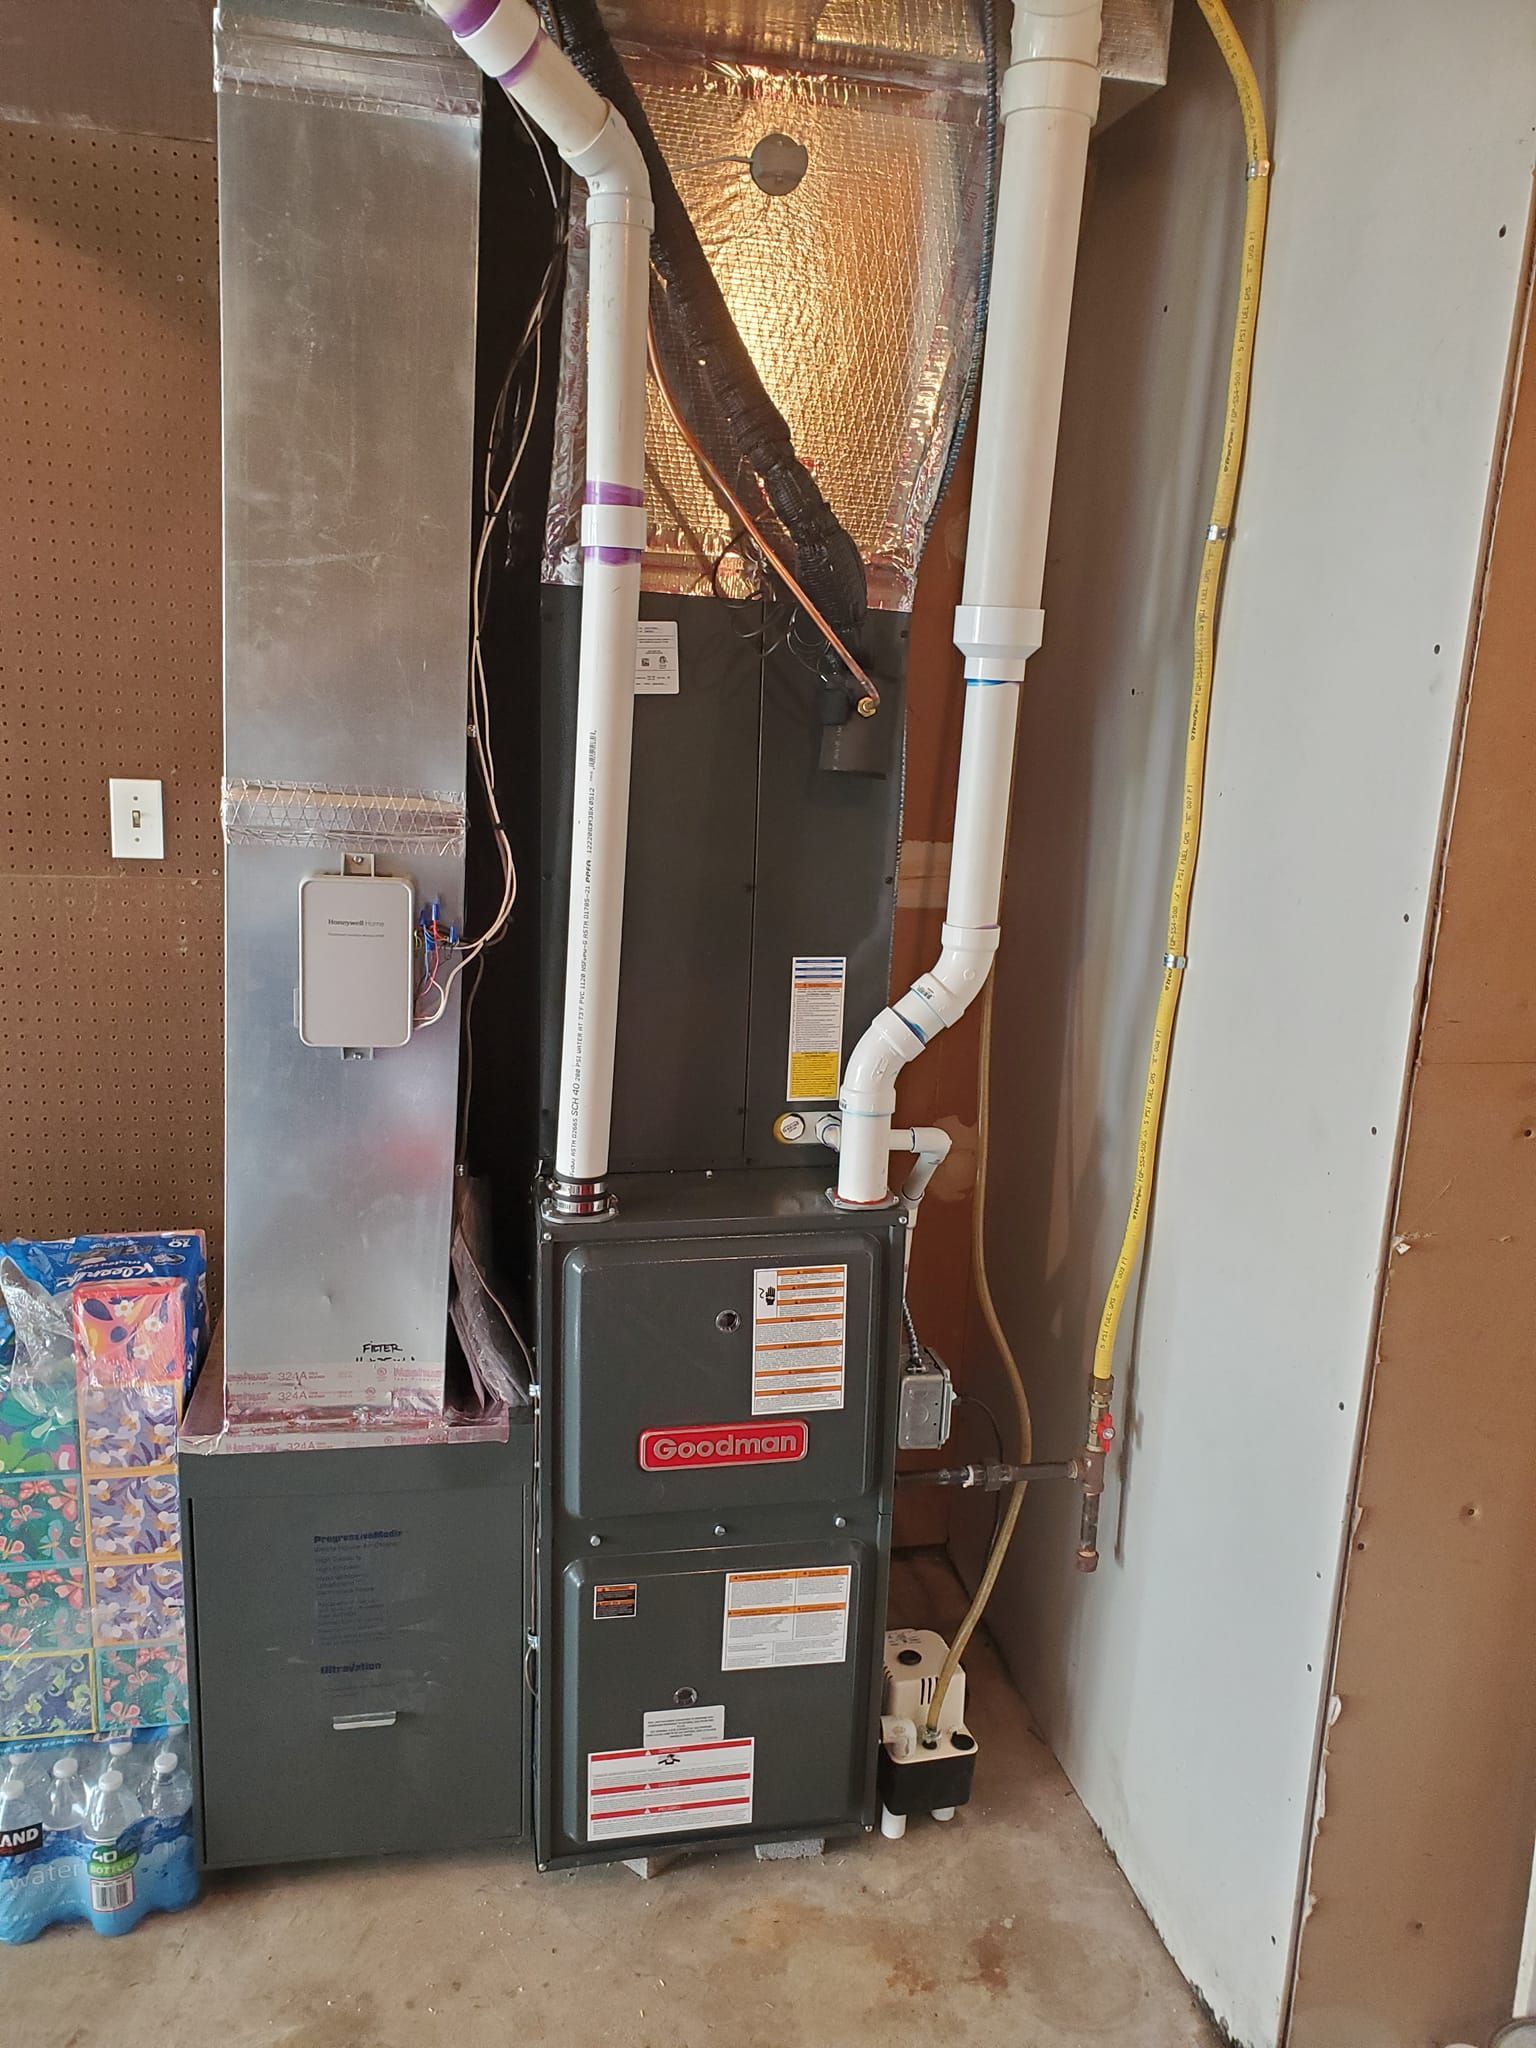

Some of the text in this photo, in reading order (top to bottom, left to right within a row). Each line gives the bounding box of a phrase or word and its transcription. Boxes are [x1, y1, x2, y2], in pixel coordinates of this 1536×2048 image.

[1241, 305, 1250, 324] FUEL
[1180, 848, 1189, 865] FUEL
[328, 918, 364, 928] Honeywell
[572, 1083, 580, 1096] 40
[1104, 1313, 1112, 1327] FUEL
[362, 1342, 404, 1354] FILTER
[278, 1371, 308, 1381] 324A
[278, 1391, 308, 1400] 324A
[653, 1434, 796, 1460] Goodman
[92, 1850, 118, 1862] 40
[90, 1860, 136, 1875] BOTTLES
[9, 1862, 80, 1891] water
